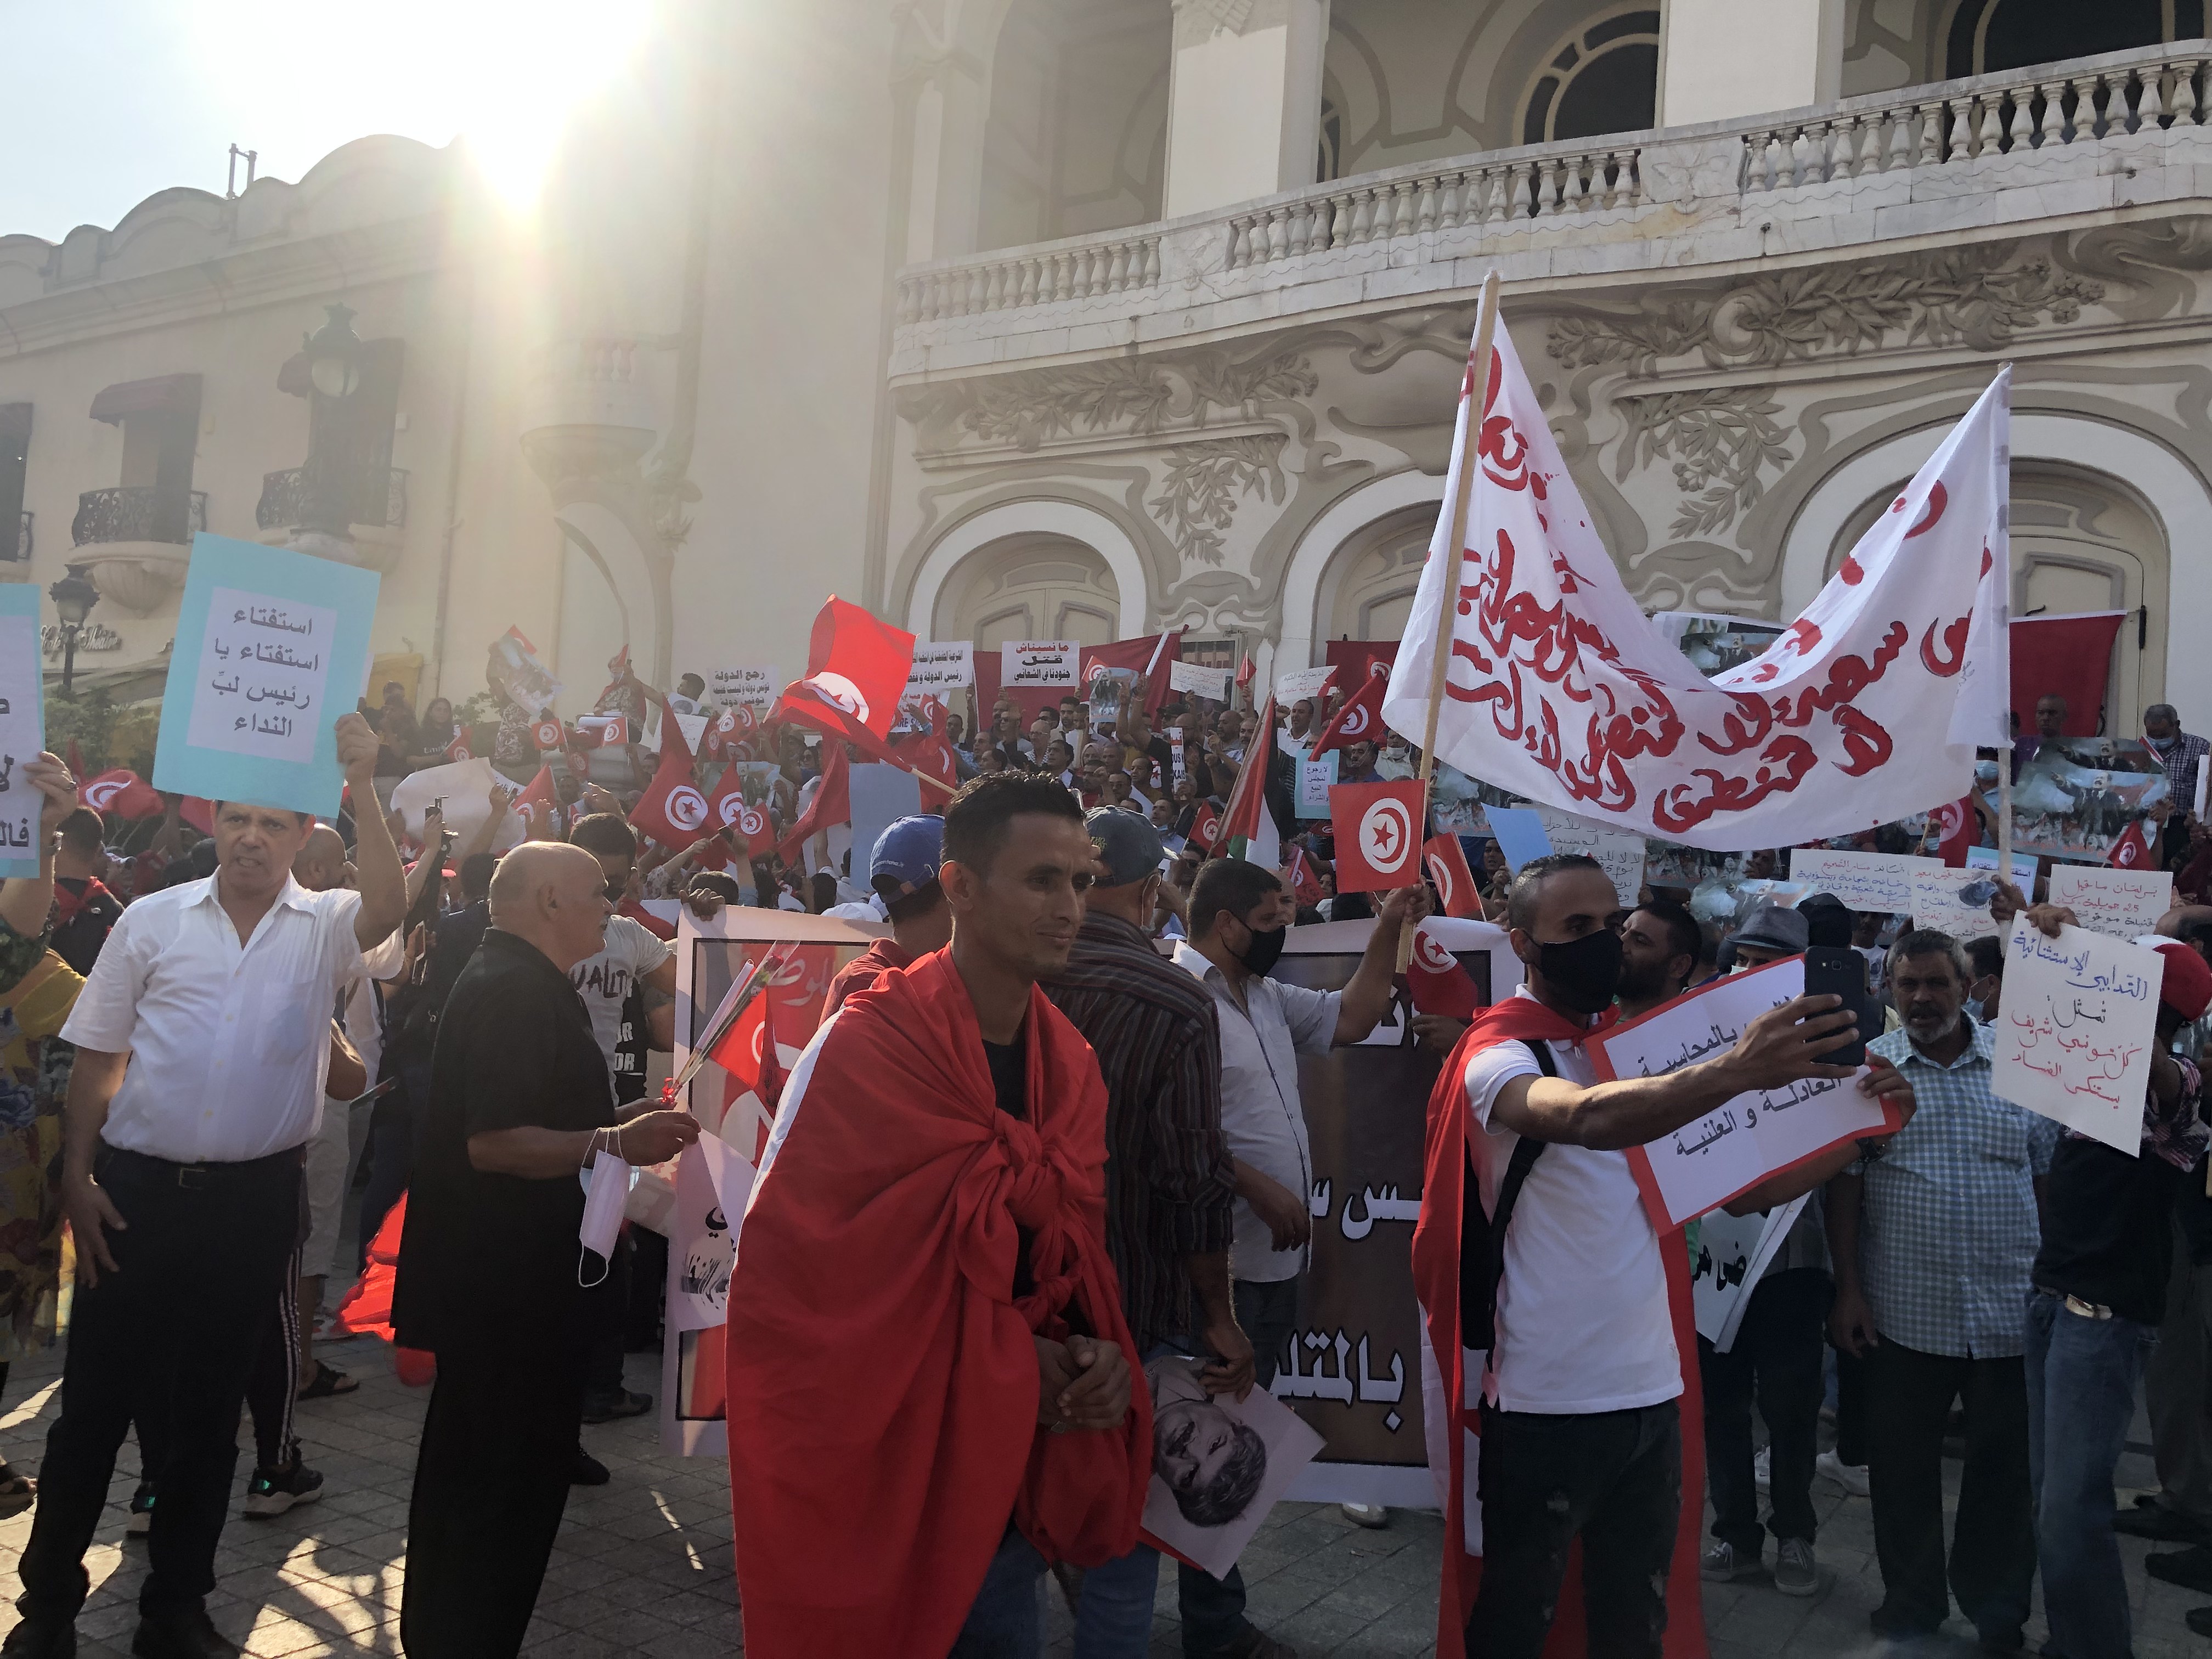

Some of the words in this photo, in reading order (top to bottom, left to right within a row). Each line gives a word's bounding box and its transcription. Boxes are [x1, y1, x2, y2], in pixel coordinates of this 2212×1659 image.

[233, 606, 312, 635] استفتاء
[215, 637, 229, 659] يا
[240, 642, 318, 671] استفتاء
[1059, 642, 1069, 652] ما
[1022, 655, 1063, 666] قتل
[715, 669, 743, 682] الدولة
[247, 686, 310, 709] رئيس
[234, 713, 292, 737] النداء
[1759, 1075, 1842, 1111] العادلة
[1745, 1108, 1757, 1128] و
[1673, 1114, 1738, 1156] العلنية
